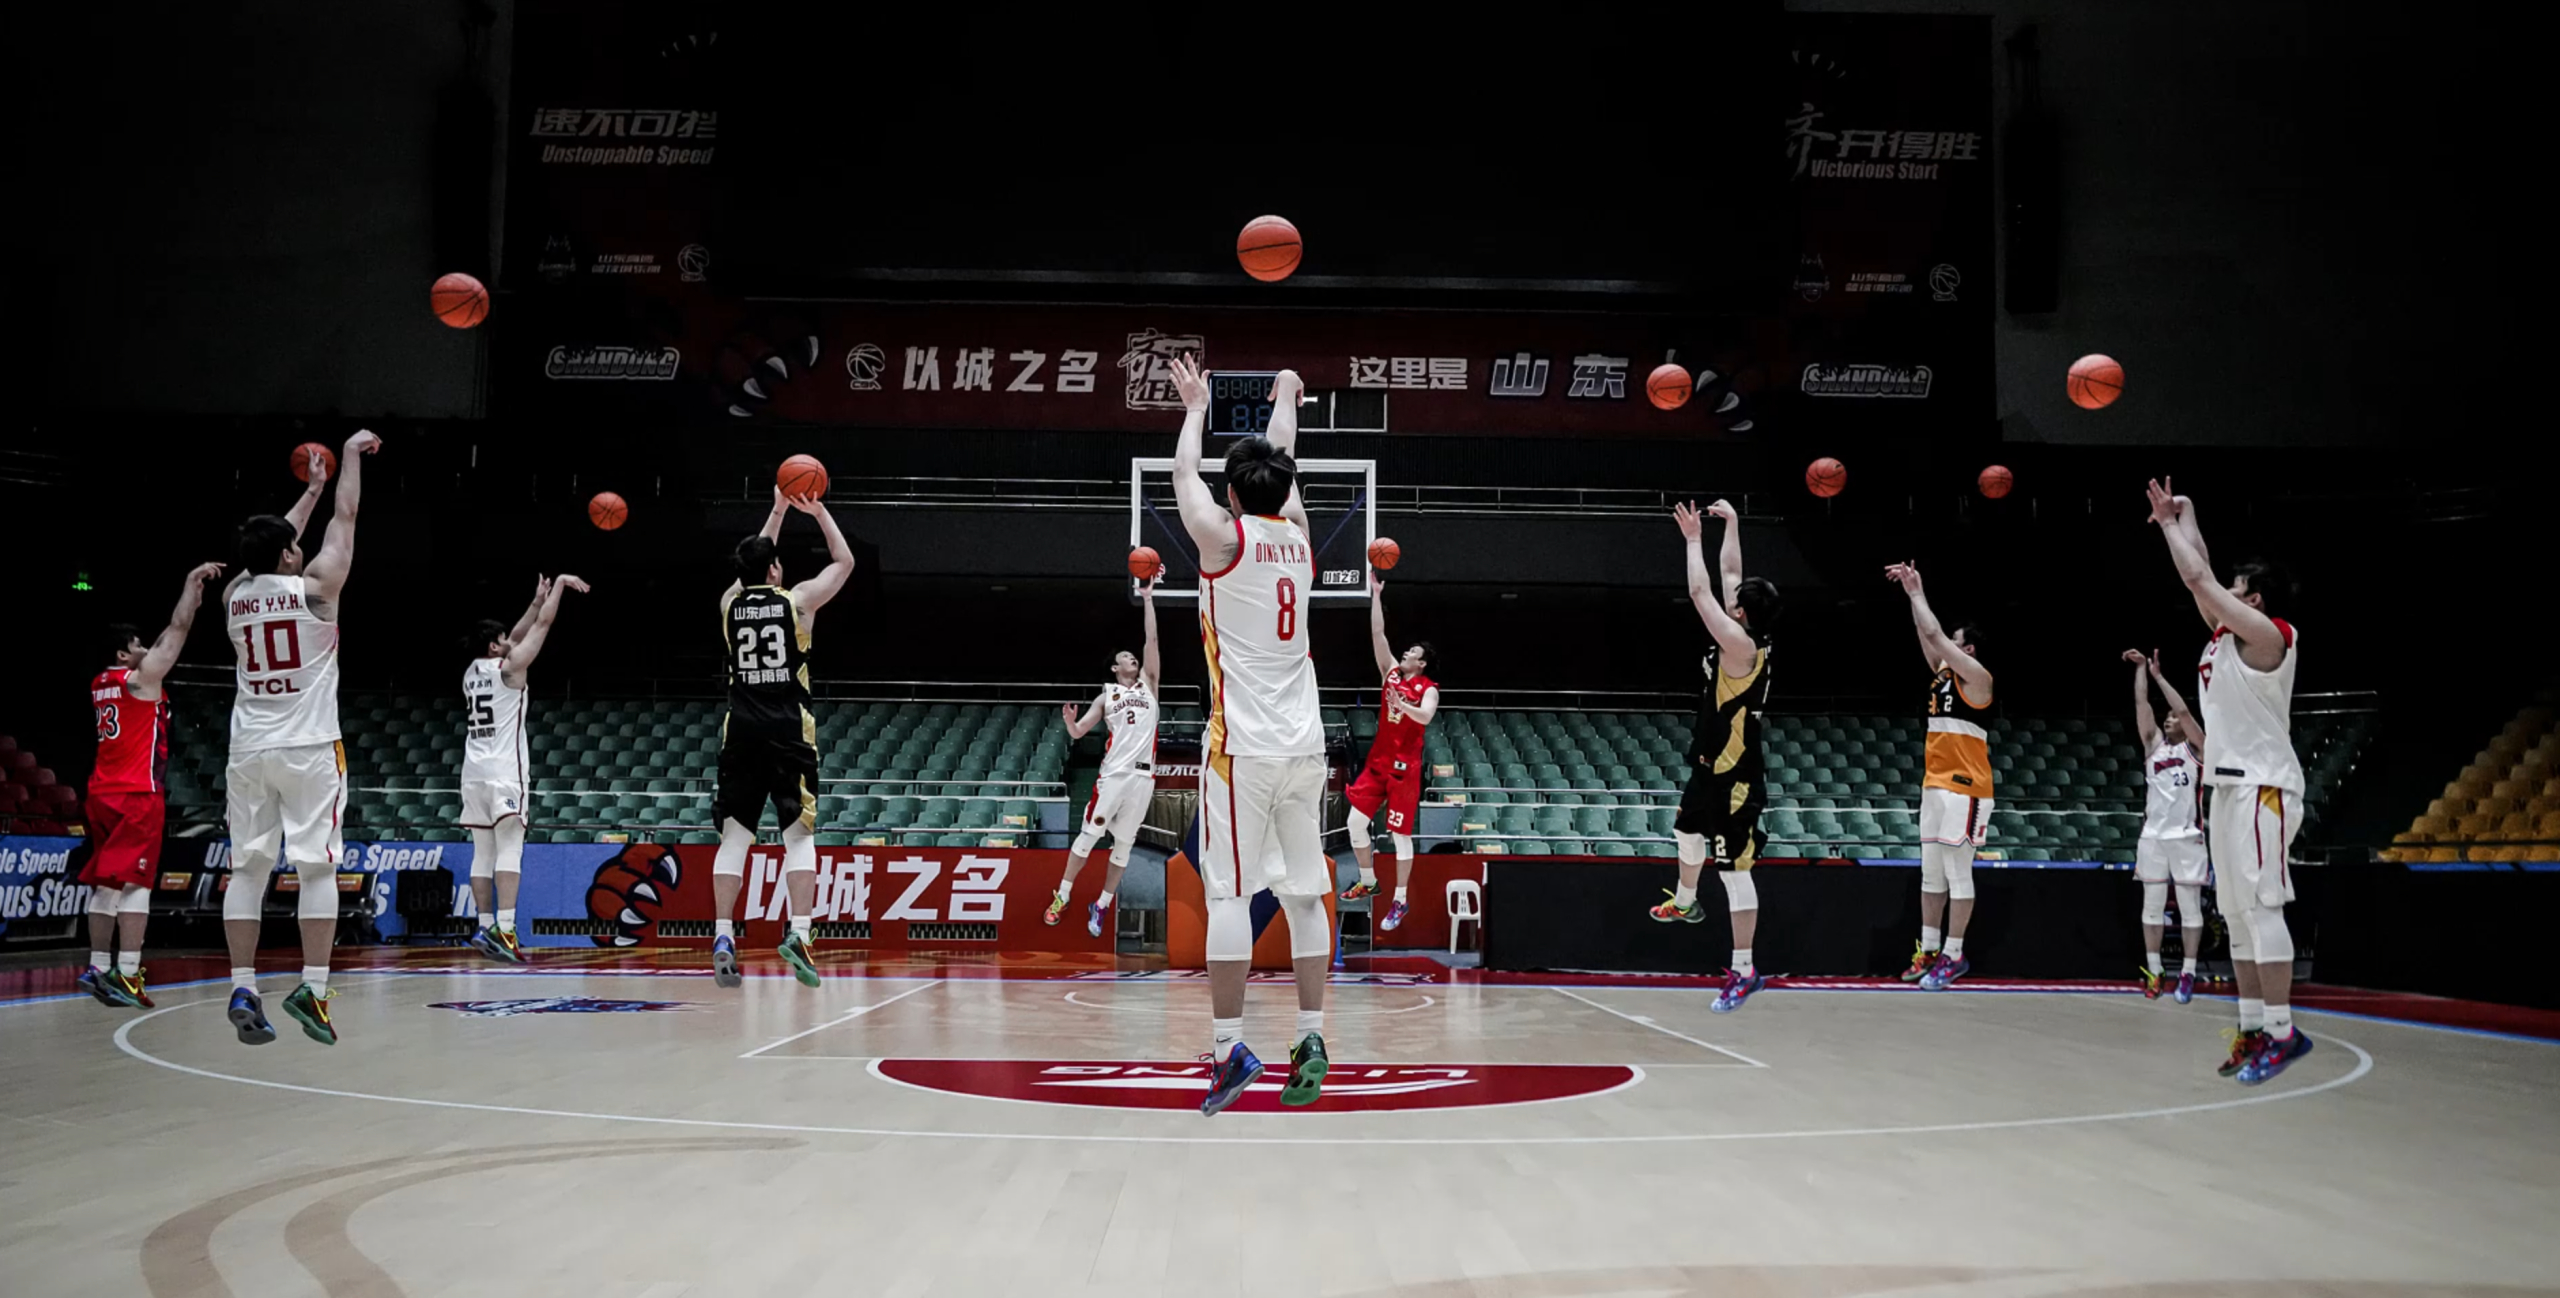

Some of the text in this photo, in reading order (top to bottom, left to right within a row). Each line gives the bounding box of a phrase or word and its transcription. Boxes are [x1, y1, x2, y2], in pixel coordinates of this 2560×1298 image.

[541, 144, 716, 166] Unstoppable Speed
[1810, 159, 1940, 181] Victorious Start
[903, 347, 1098, 393] 以城之名
[1349, 353, 1629, 398] 这里是 山东
[231, 594, 303, 616] DING Y.Y.H.
[1276, 577, 1296, 641] 8
[243, 619, 301, 672] 10
[737, 624, 787, 668] 23
[249, 678, 300, 695] TCL
[1126, 711, 1135, 724] 2
[2173, 771, 2189, 787] 23
[1388, 809, 1404, 827] 23
[18, 848, 70, 876] Speed
[363, 844, 443, 873] Speed
[744, 852, 1010, 922] 以城之名
